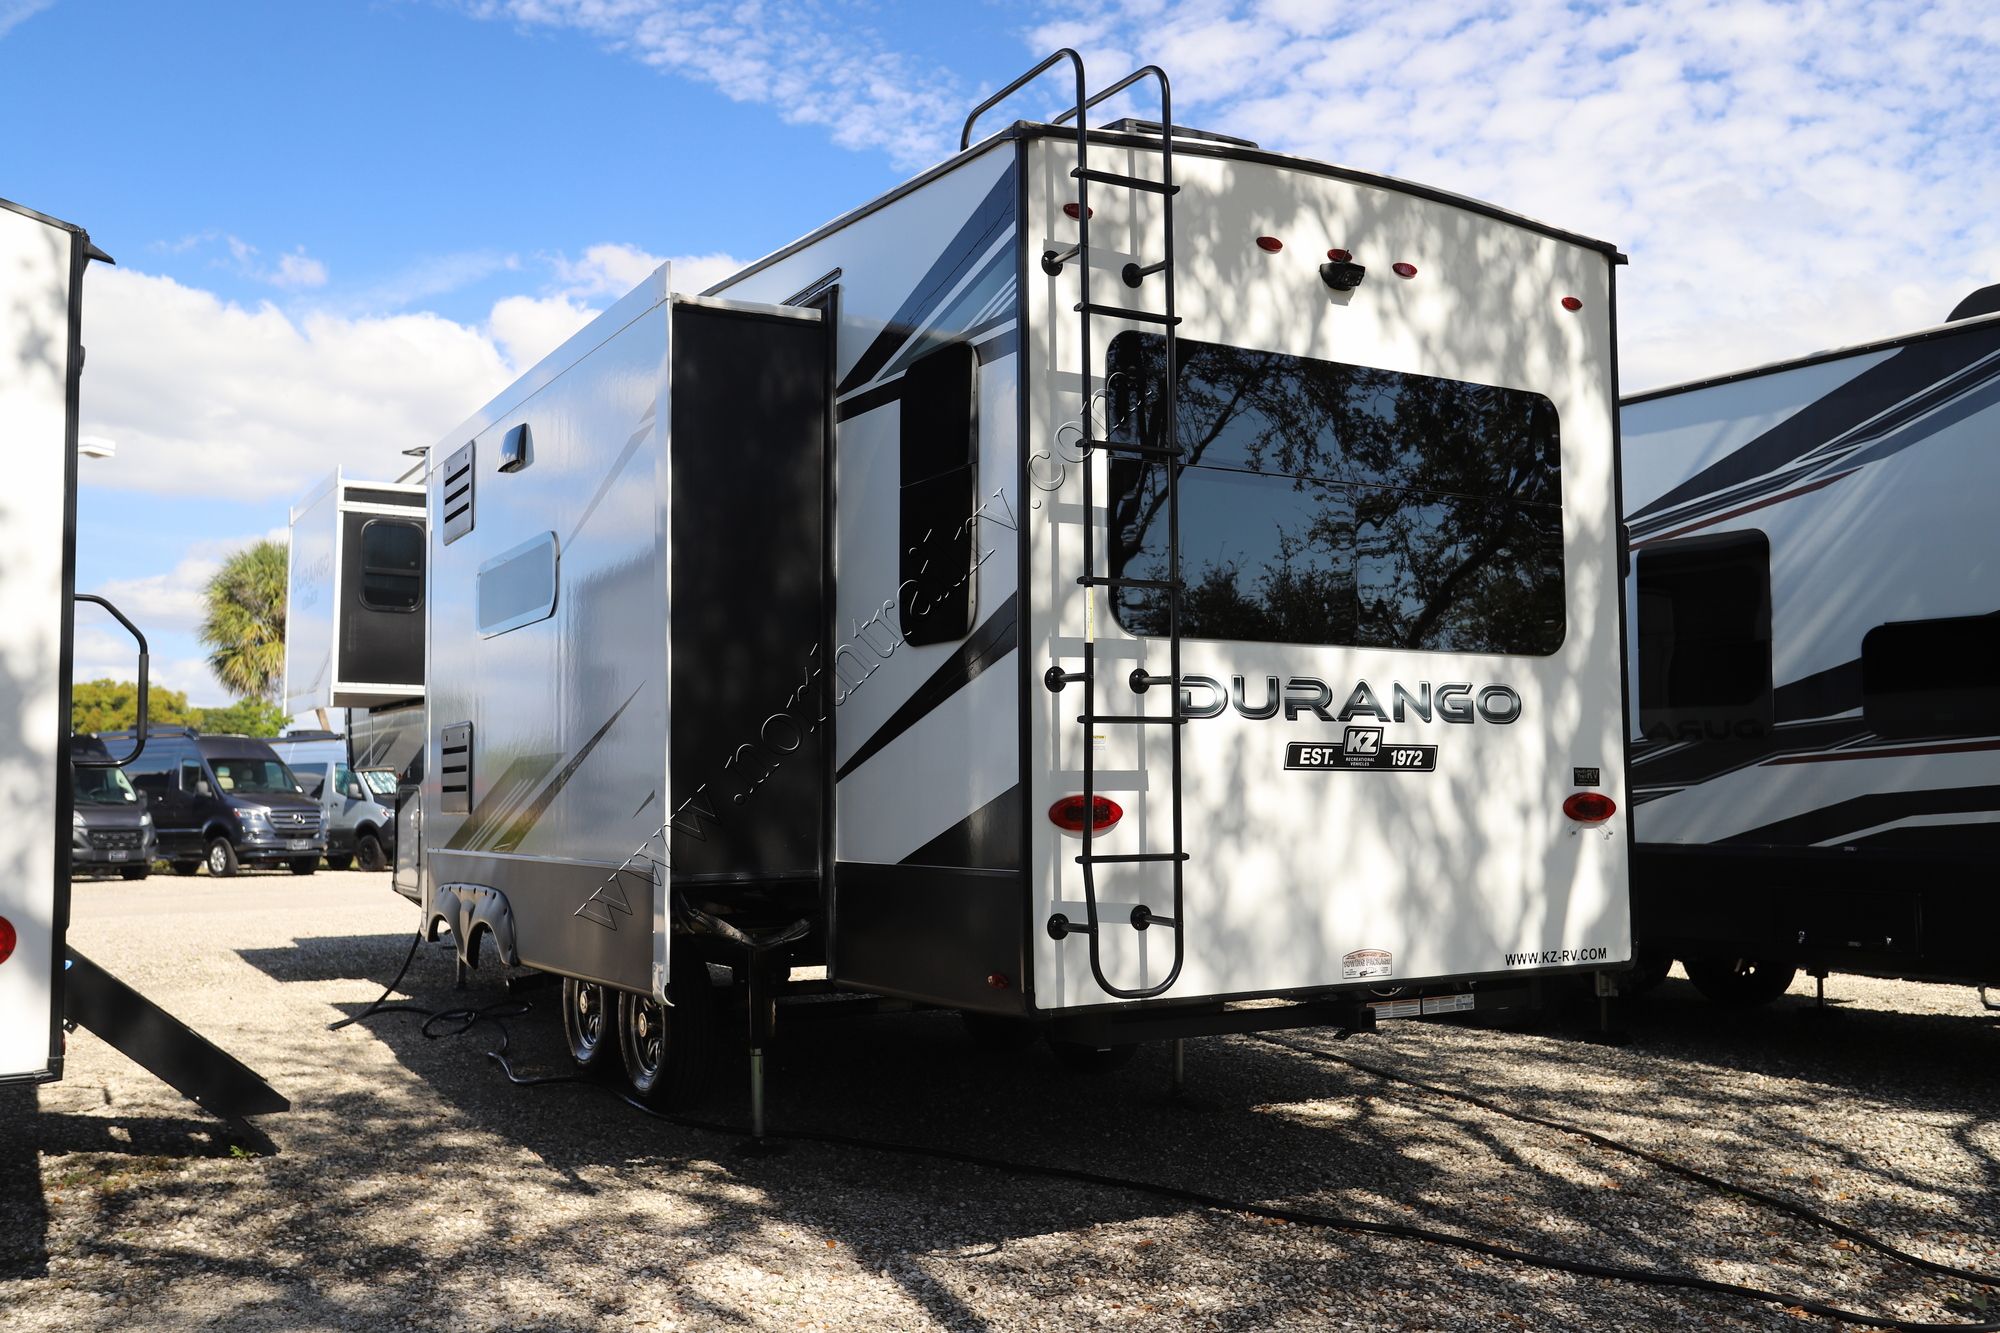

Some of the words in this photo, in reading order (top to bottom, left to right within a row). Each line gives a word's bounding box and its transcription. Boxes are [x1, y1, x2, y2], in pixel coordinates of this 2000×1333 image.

[1179, 674, 1522, 724] DURANGO
[1346, 731, 1379, 753] KZ
[1299, 747, 1334, 766] EST.
[1391, 749, 1424, 767] 1972
[1505, 947, 1607, 966] WWW.KZ-RV.COM
